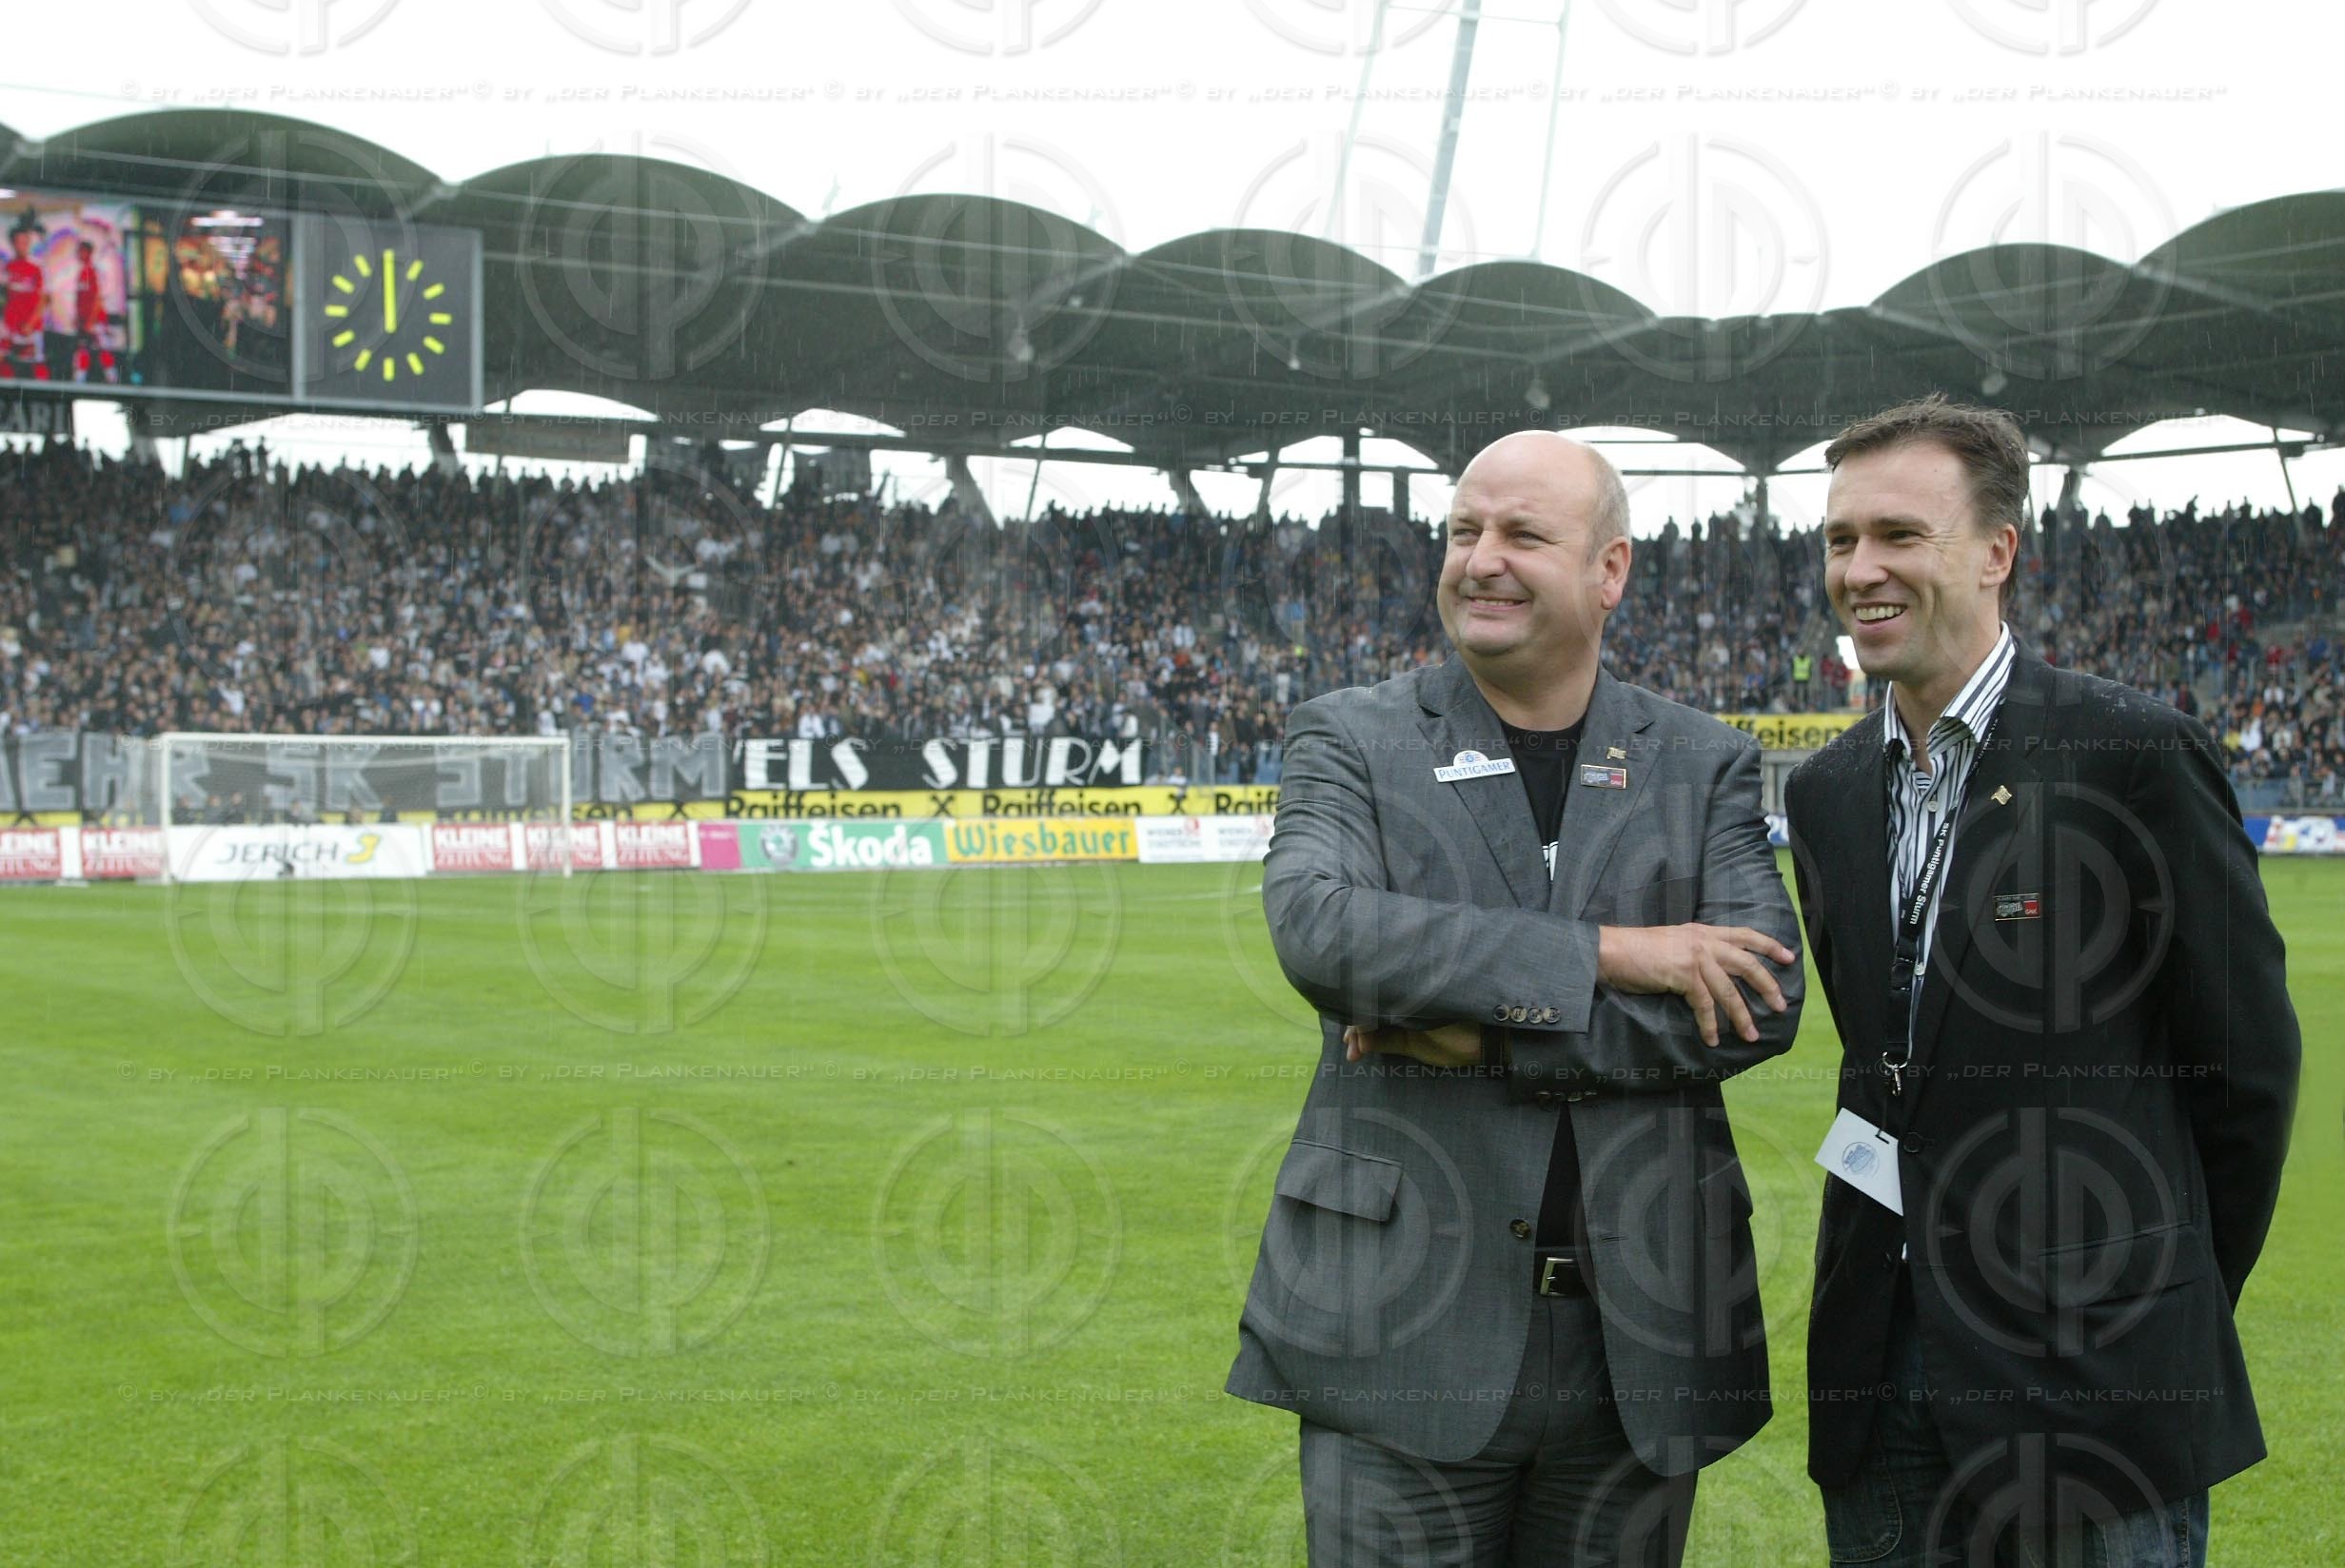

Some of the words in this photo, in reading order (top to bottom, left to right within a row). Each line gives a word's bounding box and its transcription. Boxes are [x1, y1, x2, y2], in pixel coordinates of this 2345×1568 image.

[0, 731, 208, 810] EHR
[734, 737, 869, 790] ELS
[921, 737, 1142, 790] STURM
[1438, 761, 1510, 778] PUNTIGAMER
[724, 791, 901, 819] Raiffeisen
[982, 791, 1141, 817] Raiffeisen
[216, 841, 339, 864] JERICH
[808, 819, 934, 867] Škoda
[954, 821, 1130, 857] Wiesbauer
[1909, 893, 1927, 925] Sturm
